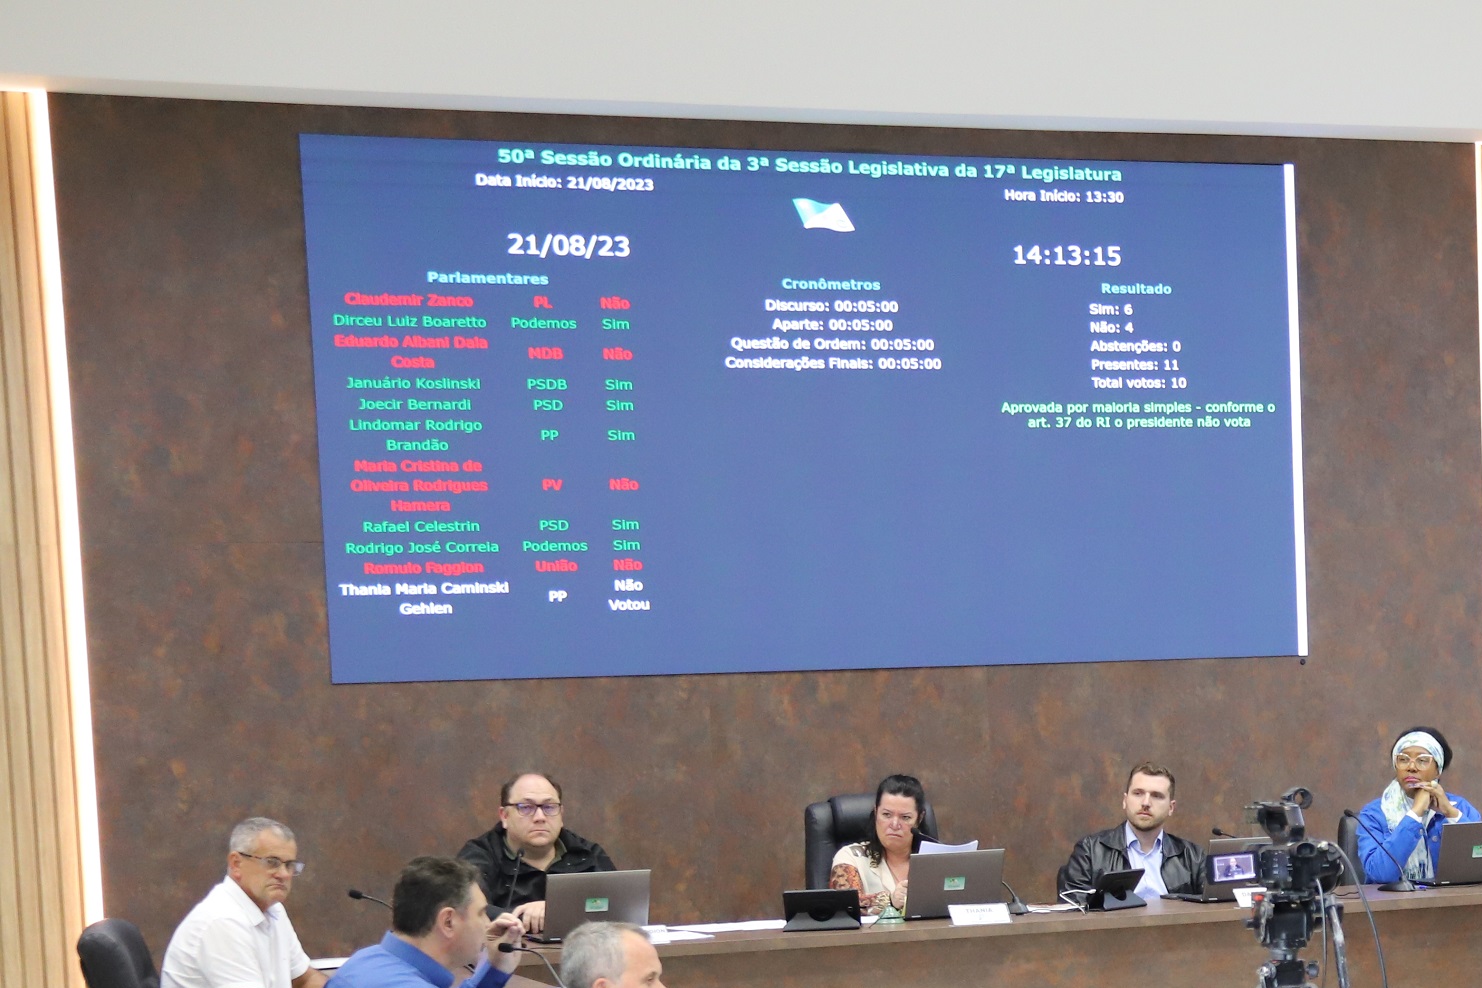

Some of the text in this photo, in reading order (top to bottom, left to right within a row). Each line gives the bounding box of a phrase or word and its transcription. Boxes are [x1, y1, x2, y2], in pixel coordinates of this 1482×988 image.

[540, 149, 612, 167] Sessão
[617, 152, 711, 170] Ordinária
[717, 155, 741, 171] da
[775, 158, 843, 173] Sessão
[848, 160, 950, 178] Legislativa
[955, 163, 978, 178] da
[1022, 166, 1122, 182] Legislatura
[475, 172, 654, 192] Data Início: 21/08/2023
[1004, 189, 1125, 203] Hora Início: 13:30
[507, 233, 630, 259] 21/08/23
[1013, 245, 1121, 266] 14:13:15
[427, 271, 549, 285] Parlamentares
[782, 278, 880, 290] Cronômetros
[1102, 283, 1172, 294] Resultado
[344, 291, 474, 307] Claudemir Zanco
[533, 295, 553, 309] PL
[600, 296, 631, 310] Não
[764, 299, 898, 313] Discurso: 00:05:00
[1089, 303, 1134, 316] Sim: 6
[333, 314, 487, 328] Dirceu Luiz Boaretto
[511, 317, 577, 329] Podemos
[602, 319, 630, 330] Sim
[772, 318, 894, 332] Aparte: 00:05:00
[1090, 321, 1134, 334] Não: 4
[334, 334, 489, 349] Eduardo Albani Dala
[730, 336, 934, 351] Questão de Ordem: 00:05:00
[1090, 340, 1181, 354] Abstenções: 0
[528, 346, 564, 360] MDB
[602, 347, 633, 360] Não
[390, 355, 436, 368] Costa
[725, 356, 942, 371] Considerações Finais: 00:05:00
[1091, 359, 1179, 371] Presentes: 11
[347, 376, 481, 390] Januário Koslinski
[527, 378, 568, 390] PSDB
[605, 379, 633, 390] Sim
[1091, 377, 1187, 388] Total votos: 10
[359, 399, 472, 410] Joecir Bernardi
[533, 400, 564, 410] PSD
[606, 400, 634, 410] Sim
[1001, 402, 1063, 415] Aprovada
[1067, 404, 1089, 415] por
[1092, 402, 1141, 413] maioria
[1144, 402, 1192, 415] simples
[1205, 401, 1264, 412] conforme
[1267, 404, 1276, 412] o
[349, 419, 483, 433] Lindomar Rodrigo
[1028, 416, 1252, 430] art. 37 do RI o presidente não vota
[541, 430, 559, 440] PP
[608, 430, 636, 440] Sim
[386, 439, 449, 450] Brandão
[354, 460, 483, 472] Maria Cristina de
[350, 479, 489, 494] Oliveira Rodrigues
[542, 478, 563, 491] PV
[609, 477, 640, 491] Não
[390, 500, 451, 512] Hamera
[363, 520, 480, 533] Rafael Celestrin
[539, 520, 570, 530] PSD
[612, 519, 640, 531] Sim
[346, 541, 500, 556] Rodrigo José Correia
[523, 540, 588, 552] Podemos
[613, 540, 641, 550] Sim
[363, 561, 485, 576] Romulo Faggion
[535, 559, 578, 572] União
[613, 558, 643, 571] Não
[338, 581, 509, 596] Thania Maria Caminski
[614, 579, 643, 591] Não
[549, 590, 568, 602] PP
[399, 602, 453, 615] Gehlen
[608, 599, 651, 610] Votou
